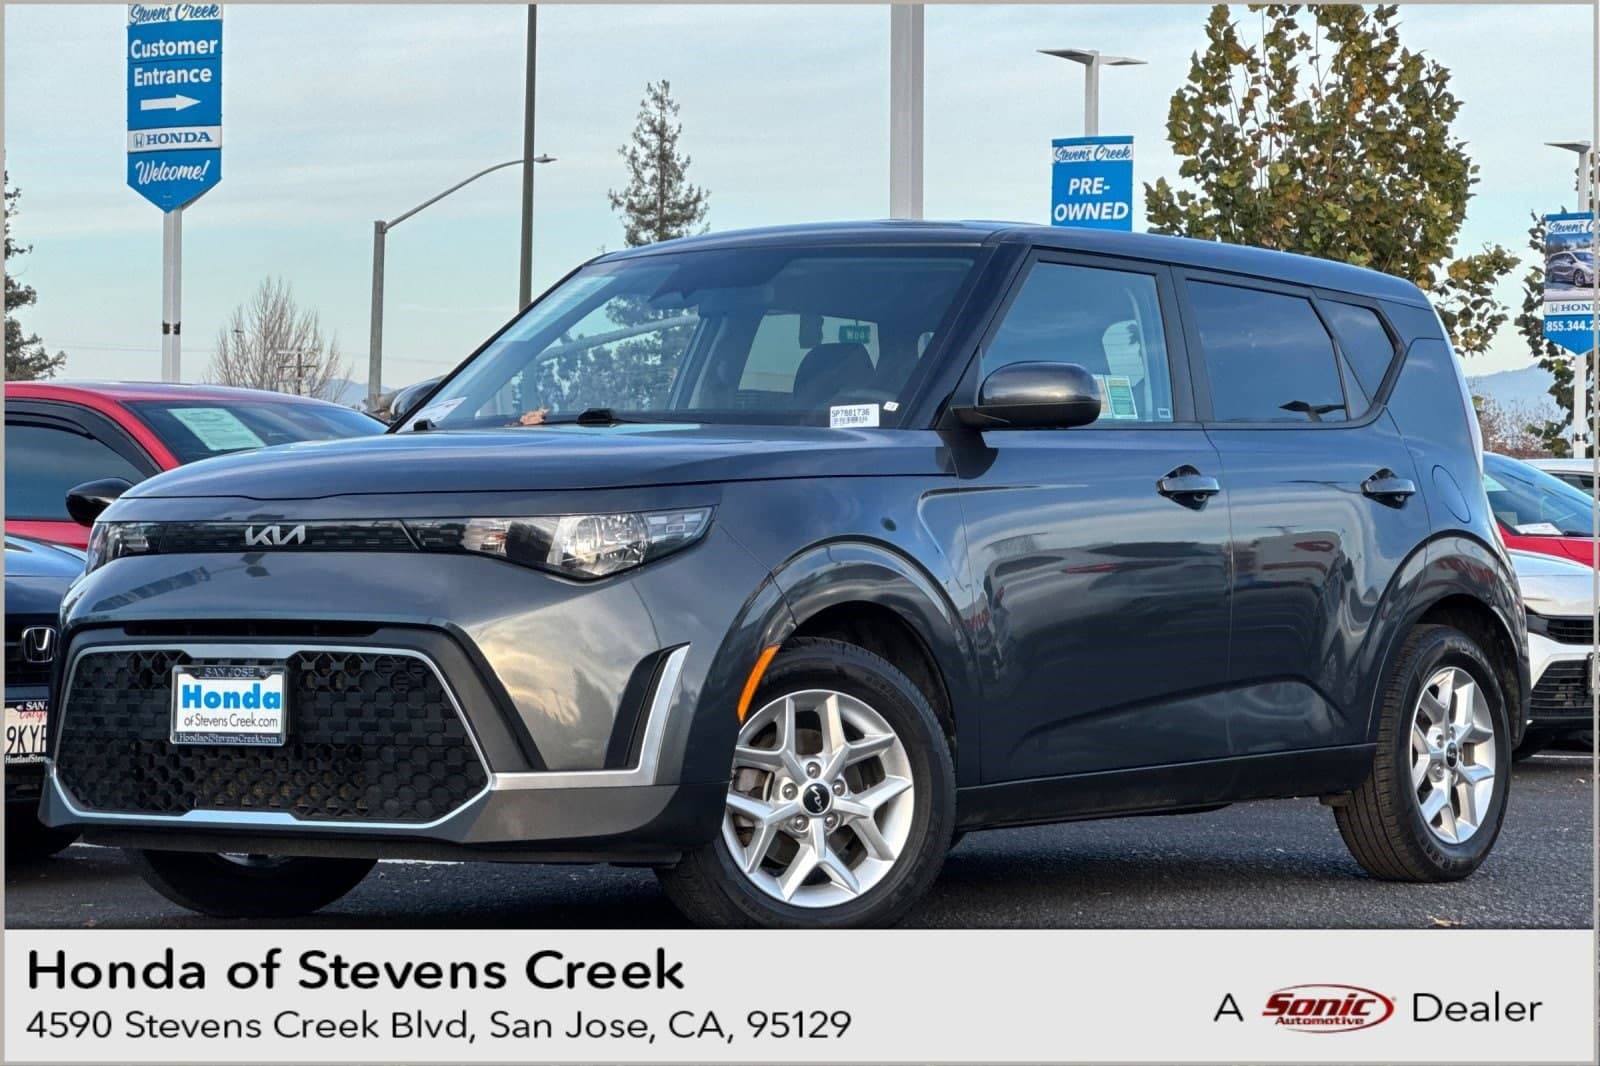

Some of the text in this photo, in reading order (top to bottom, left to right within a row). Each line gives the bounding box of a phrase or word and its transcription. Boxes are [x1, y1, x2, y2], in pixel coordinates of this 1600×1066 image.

[130, 4, 220, 26] Stevens Creek
[131, 40, 218, 59] Customer
[134, 67, 212, 87] Entrance
[146, 131, 213, 146] HONDA
[1055, 144, 1130, 163] Stevens Creek
[135, 160, 211, 185] Welcome!
[1068, 177, 1111, 196] PRE-
[1054, 201, 1129, 222] OWNED
[1560, 303, 1595, 312] HON
[1546, 320, 1595, 333] 855.344.2
[245, 525, 306, 546] KIA
[204, 667, 255, 678] SAN JOSE
[182, 683, 281, 709] Honda
[26, 701, 45, 711] SAN
[184, 712, 278, 728] of Stevens Creek.com
